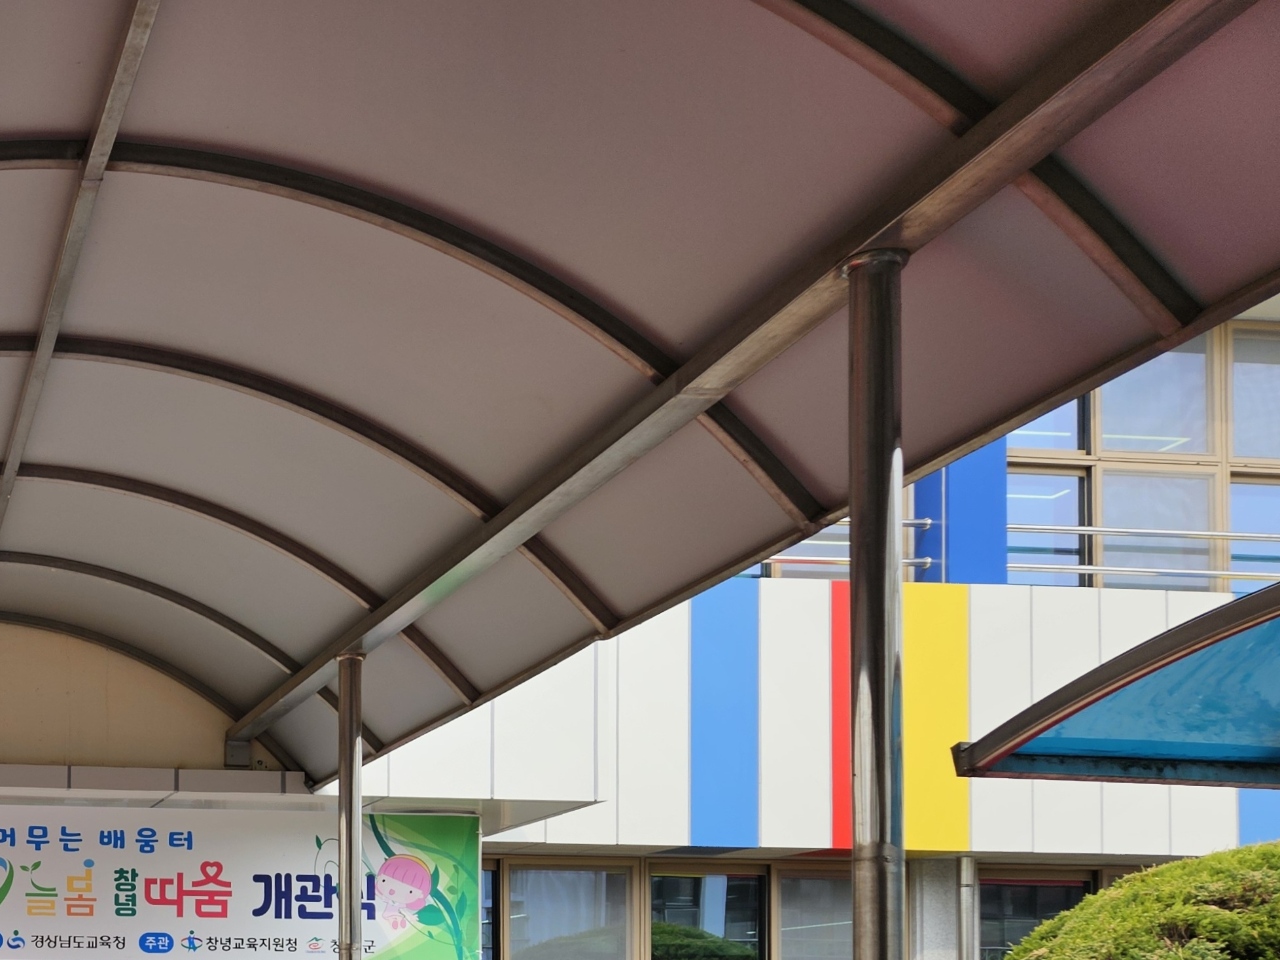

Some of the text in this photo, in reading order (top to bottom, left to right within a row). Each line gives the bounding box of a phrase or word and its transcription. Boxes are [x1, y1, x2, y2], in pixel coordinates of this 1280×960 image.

[99, 828, 194, 854] 배움터
[114, 868, 139, 917] 창녕
[144, 861, 233, 918] 따숨
[31, 935, 126, 950] 경상남도교육청
[144, 936, 170, 950] 주관
[206, 936, 298, 952] 창녕교육지원청
